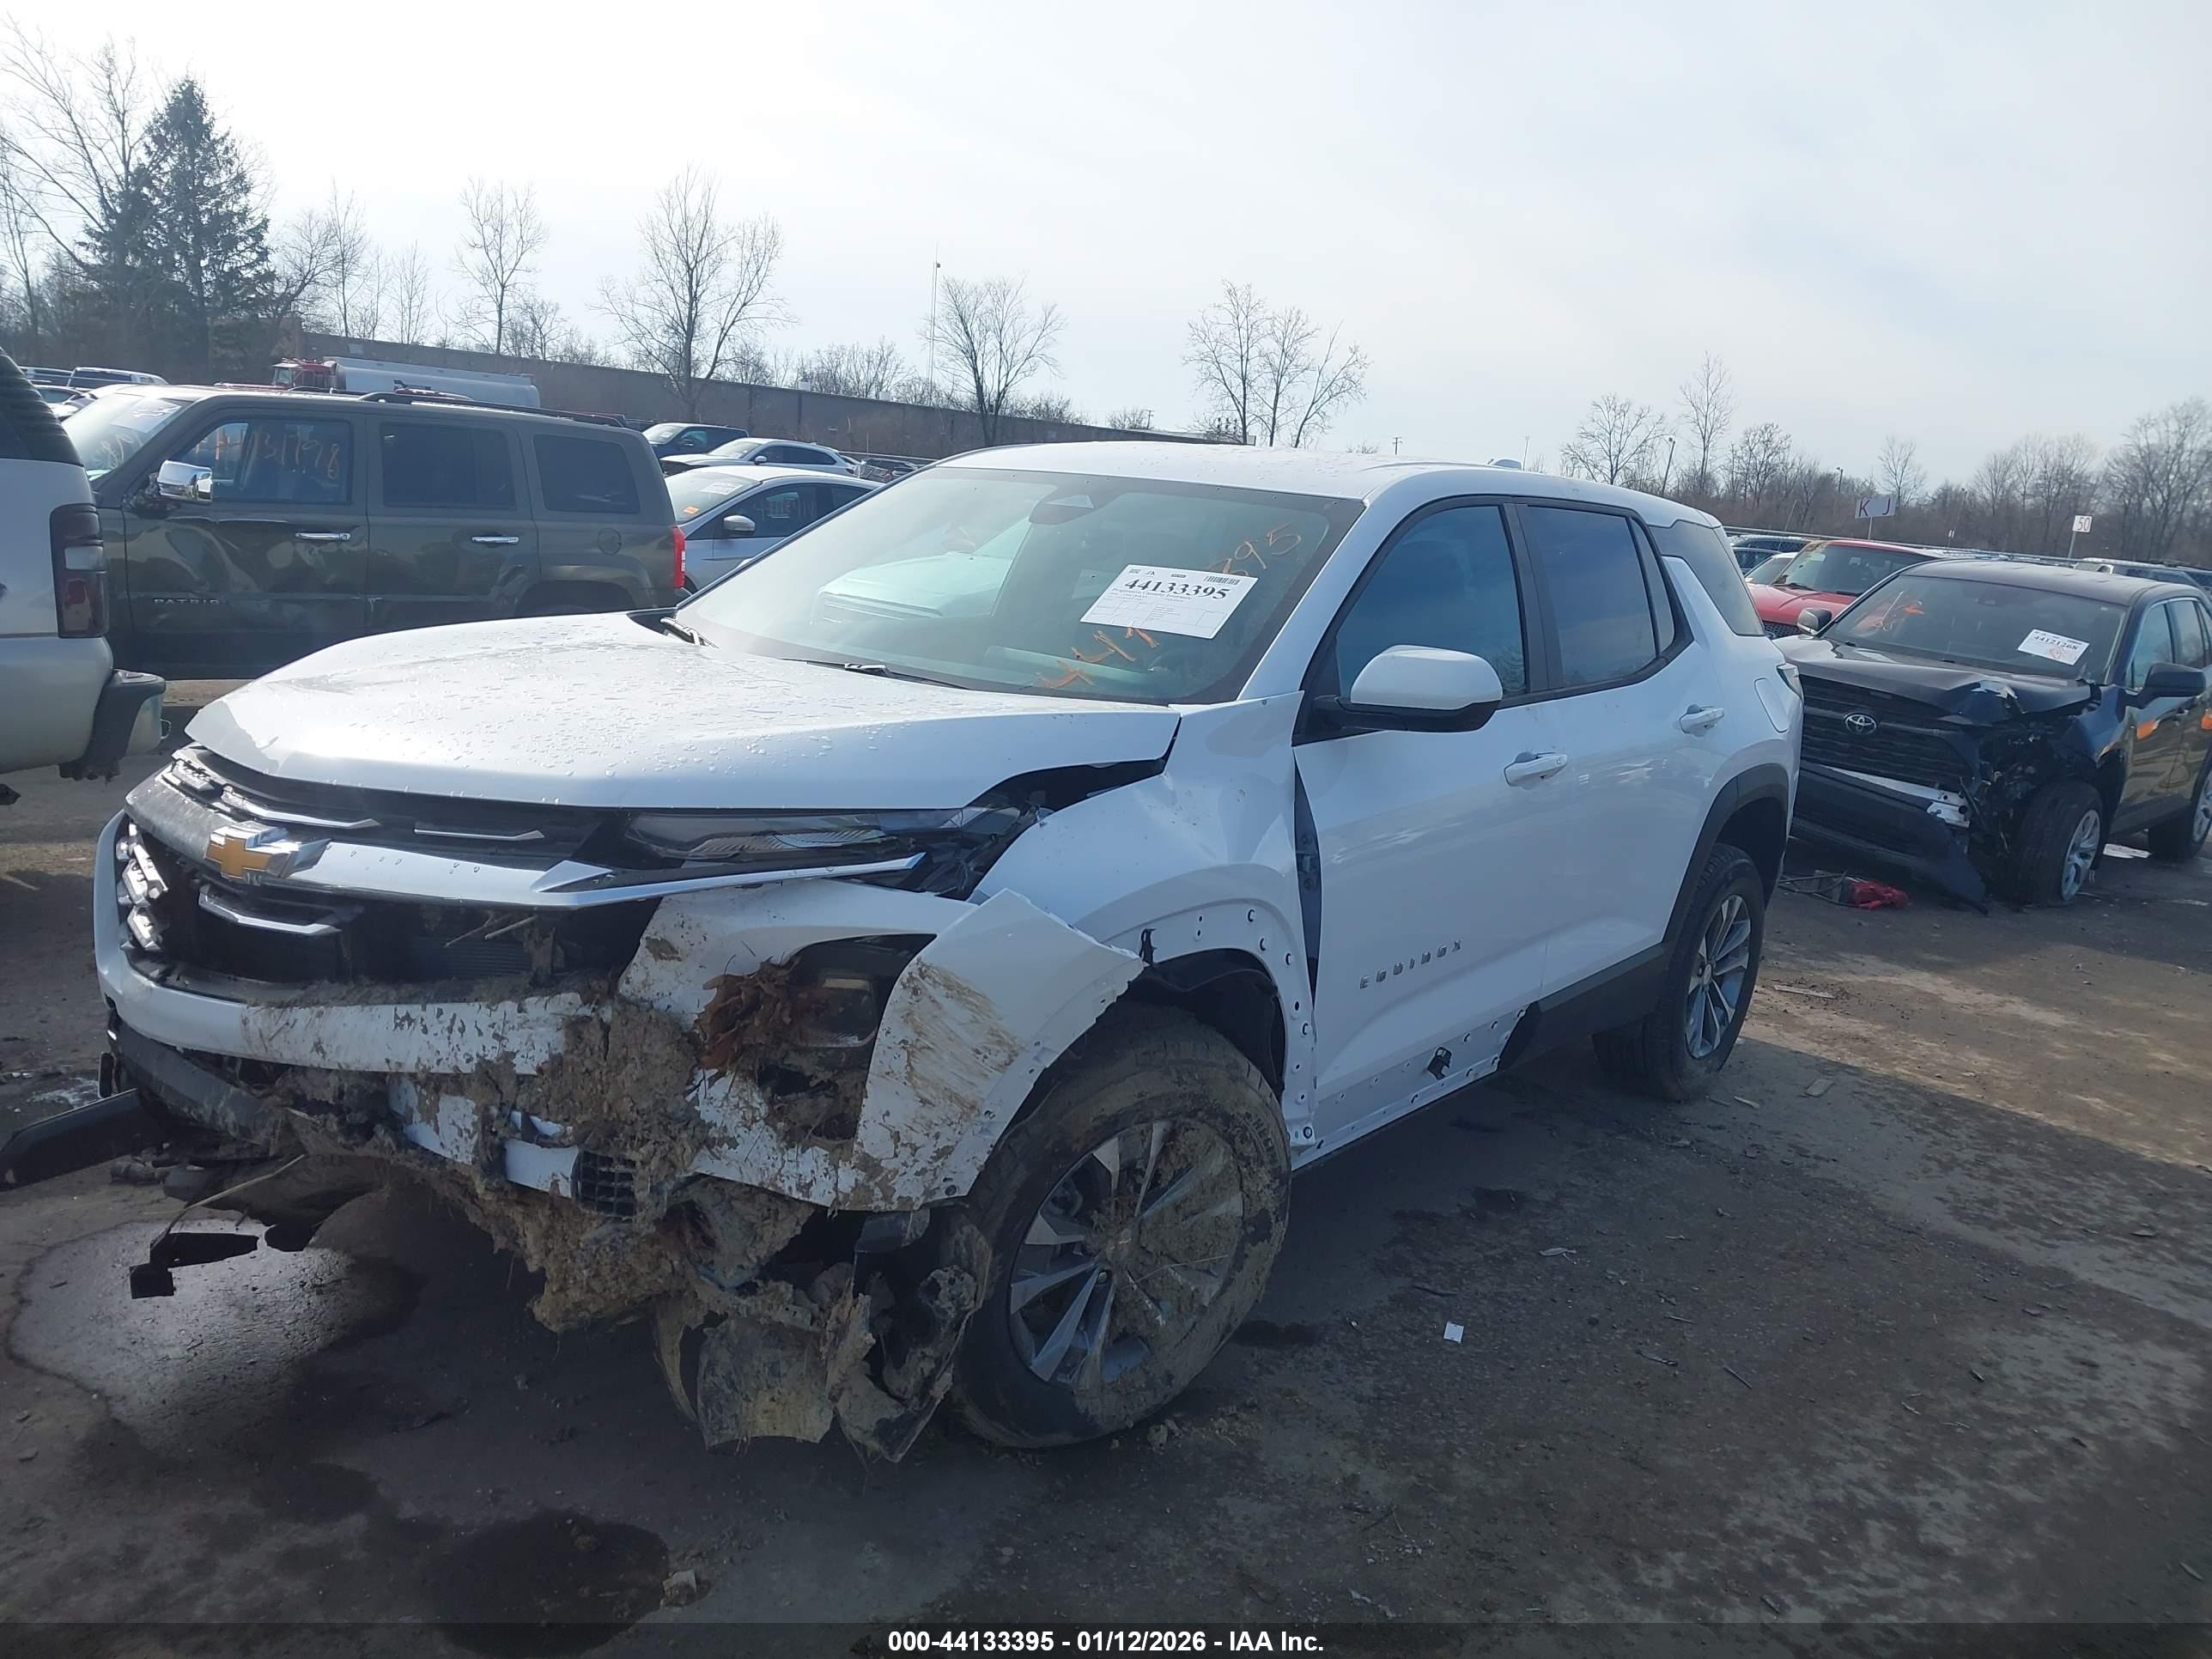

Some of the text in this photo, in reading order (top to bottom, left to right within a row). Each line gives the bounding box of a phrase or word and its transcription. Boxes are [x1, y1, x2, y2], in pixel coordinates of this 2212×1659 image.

[1859, 498, 1891, 517] K J
[2077, 517, 2090, 531] 50
[1125, 579, 1230, 599] 44133395
[1360, 940, 1461, 989] EQUINOX
